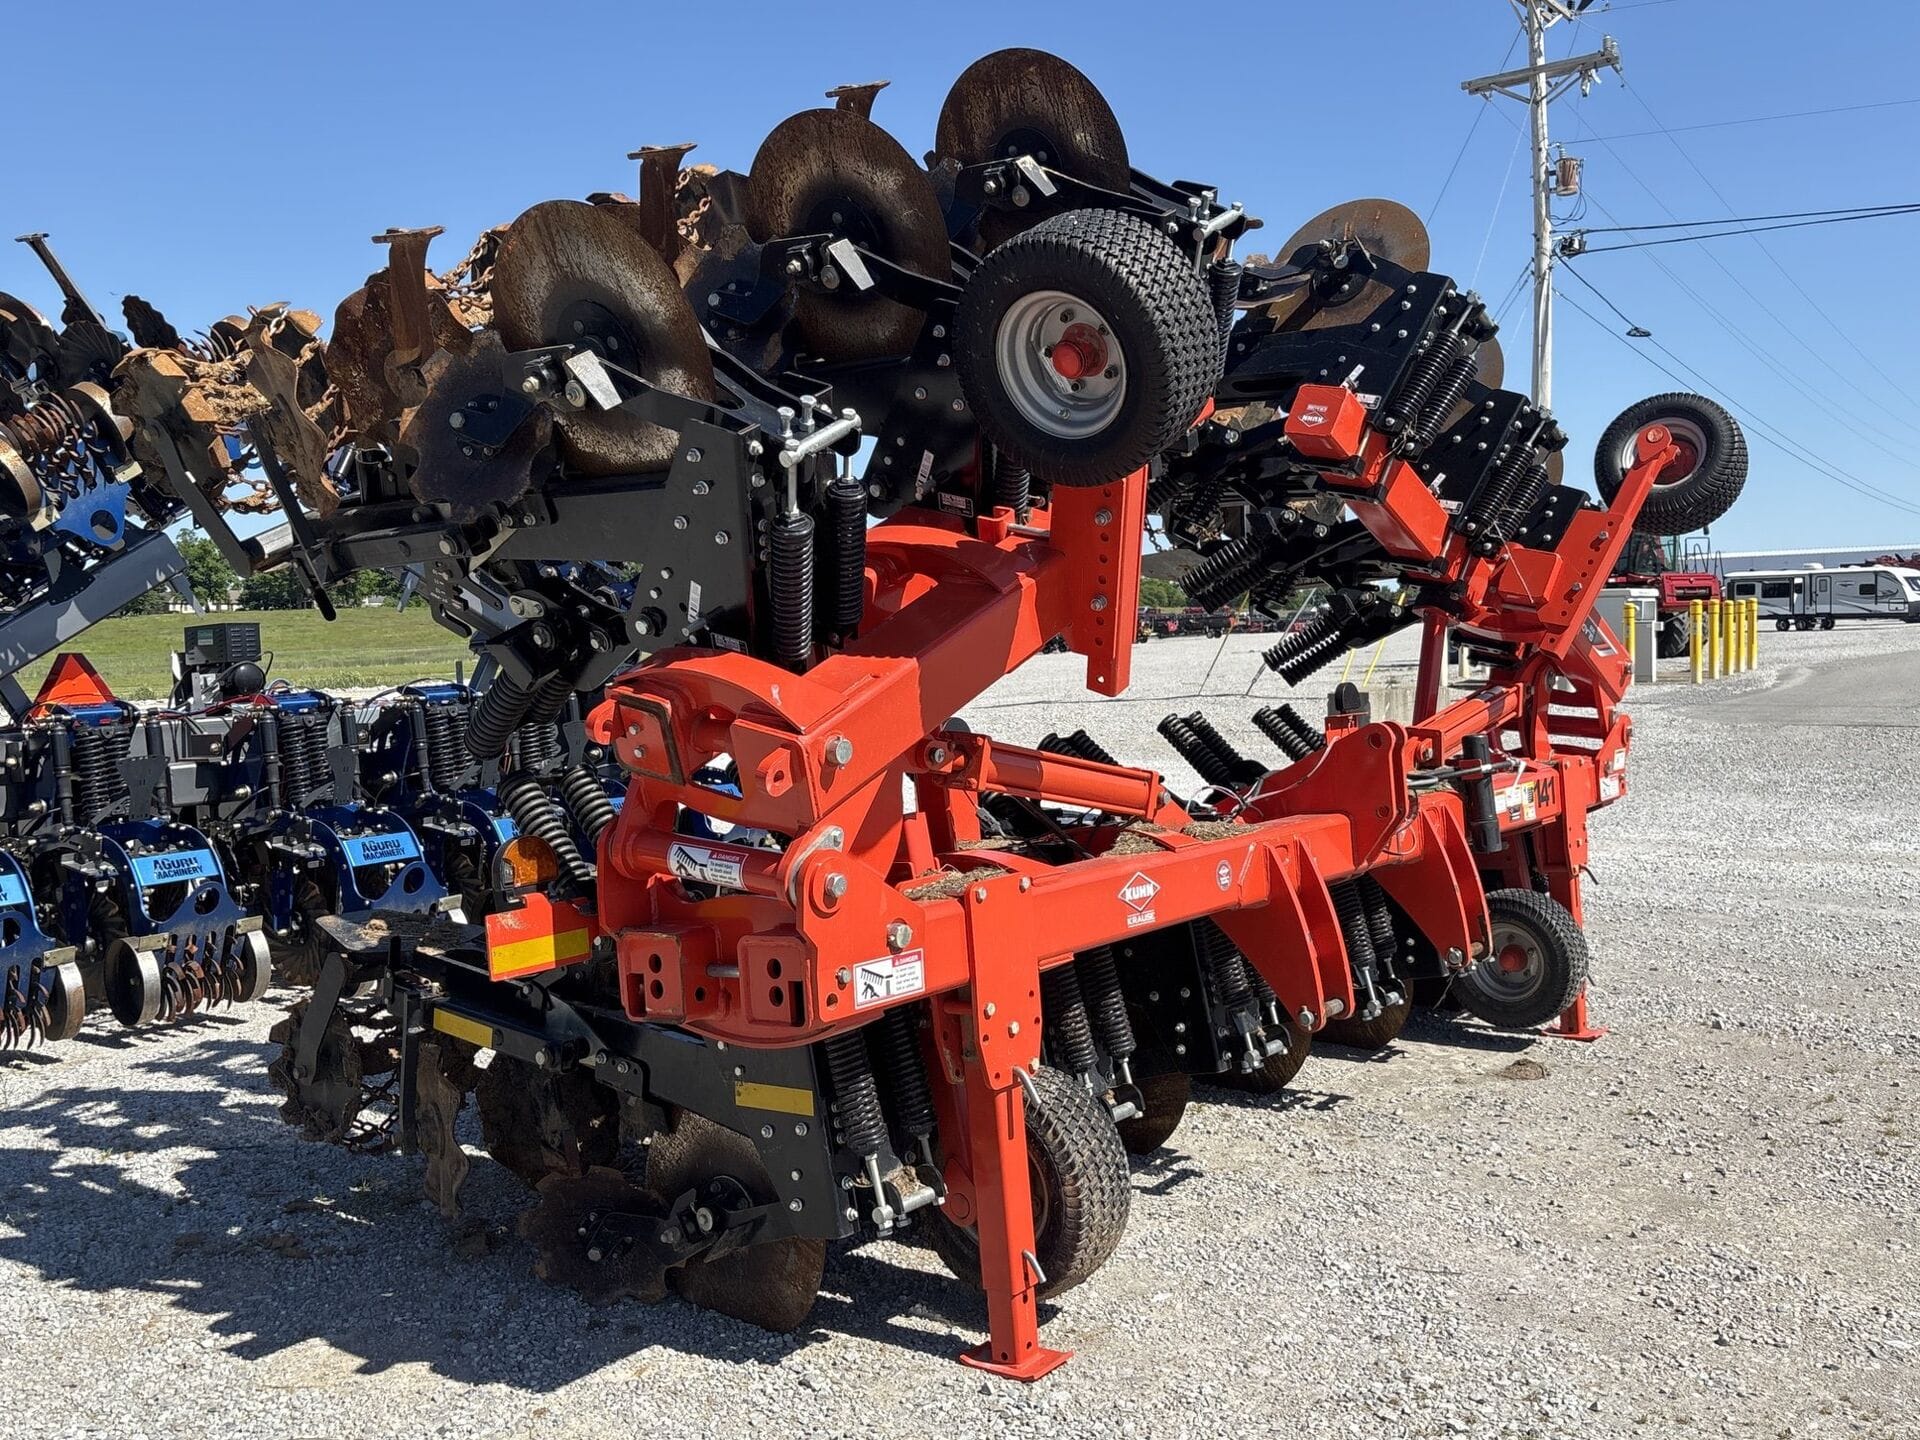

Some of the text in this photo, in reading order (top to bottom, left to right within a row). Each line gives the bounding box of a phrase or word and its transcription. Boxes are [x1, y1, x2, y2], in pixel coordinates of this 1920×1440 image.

[1301, 414, 1324, 423] KUHN
[1534, 776, 1556, 808] 141
[361, 839, 401, 853] AGURU
[362, 847, 406, 861] MACHINERY
[153, 856, 199, 871] AGURU
[154, 864, 204, 880] MACHINERY
[1125, 882, 1154, 901] KUHN
[1129, 912, 1154, 924] KRAUSE
